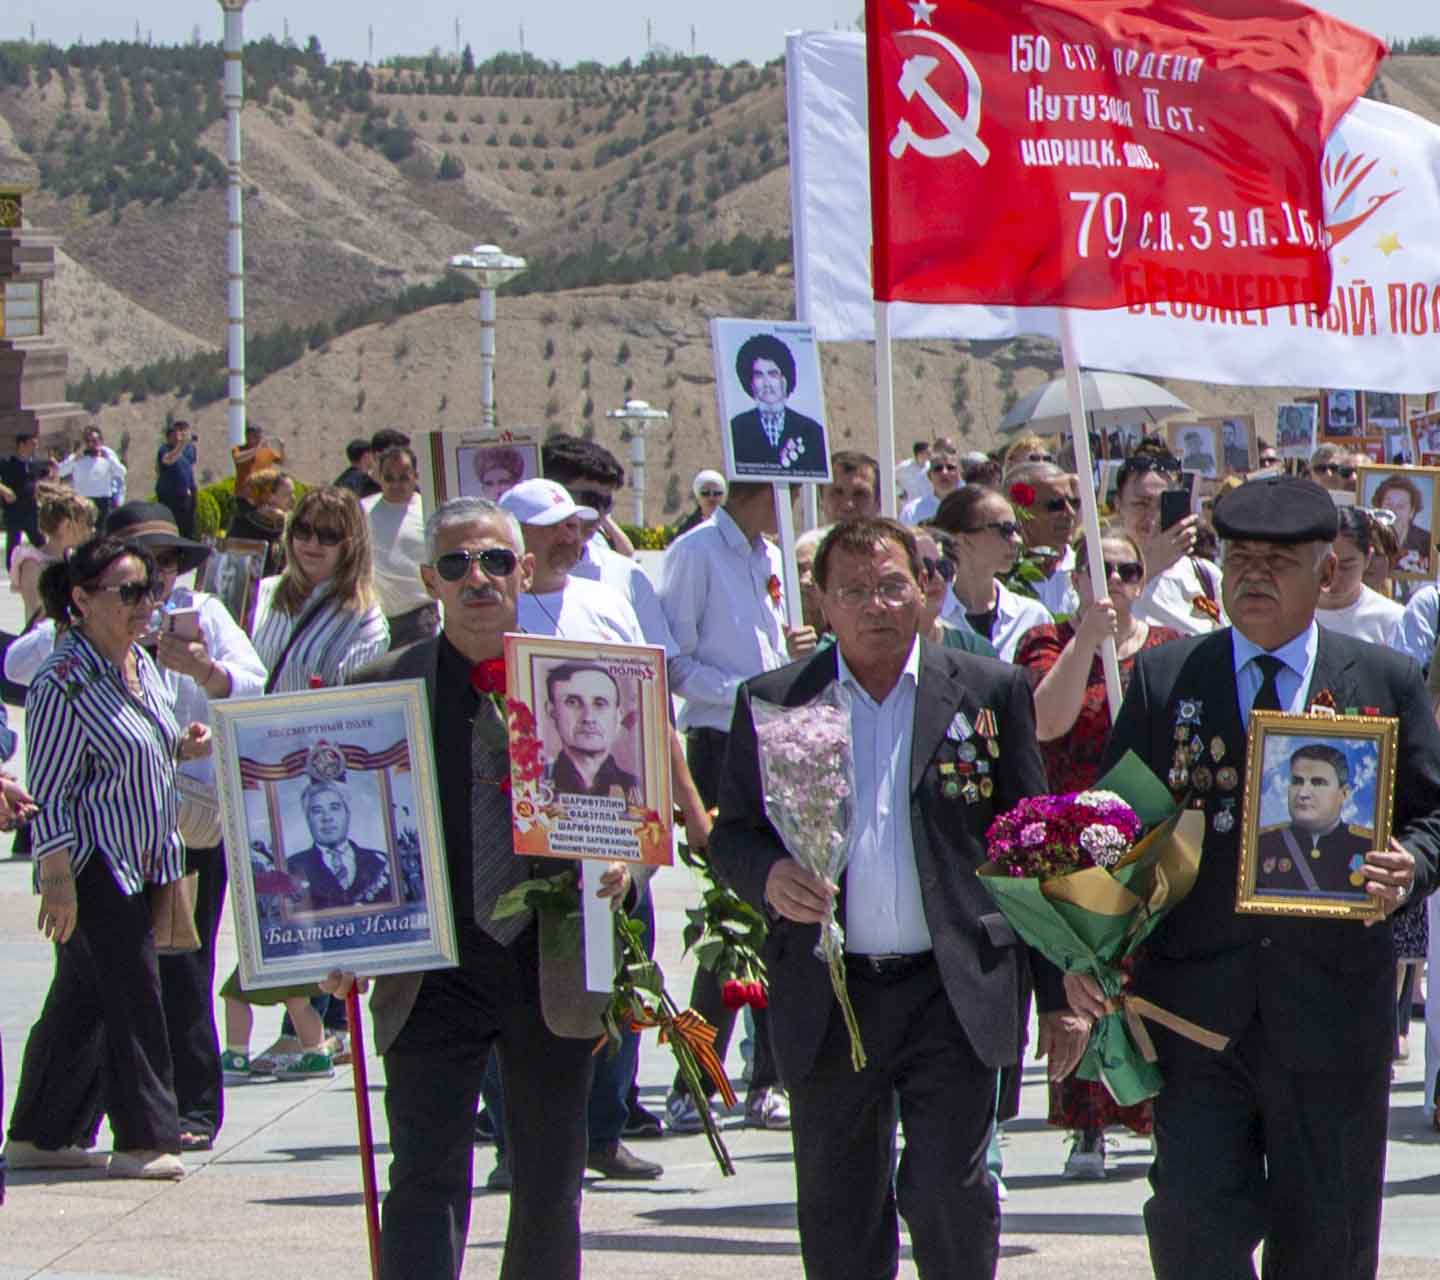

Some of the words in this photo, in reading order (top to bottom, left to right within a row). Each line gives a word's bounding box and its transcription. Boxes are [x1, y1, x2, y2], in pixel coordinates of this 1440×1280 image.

[1011, 35, 1050, 72] 150
[1069, 191, 1128, 258] 79
[265, 921, 354, 945] Бахтаев
